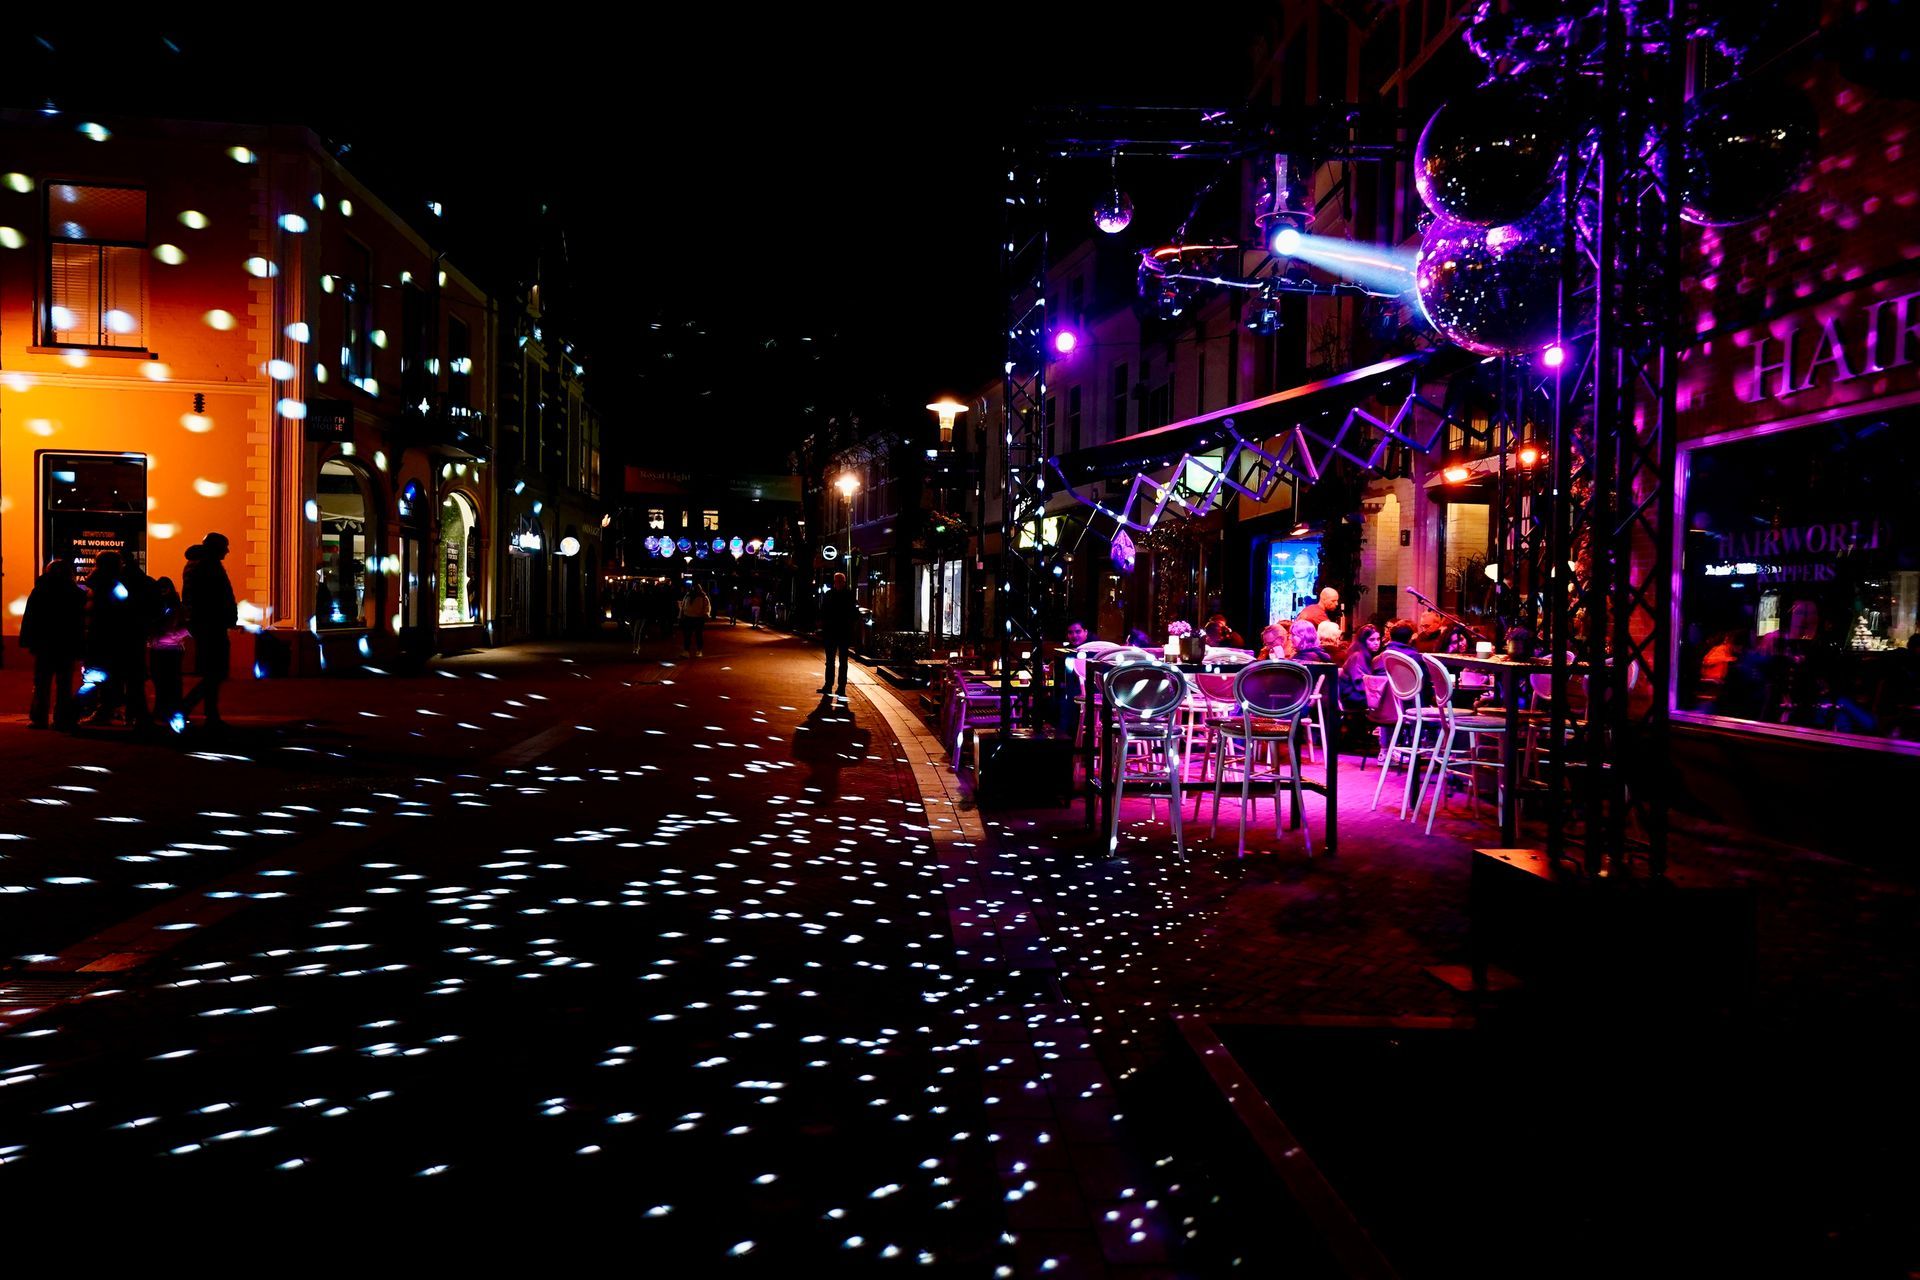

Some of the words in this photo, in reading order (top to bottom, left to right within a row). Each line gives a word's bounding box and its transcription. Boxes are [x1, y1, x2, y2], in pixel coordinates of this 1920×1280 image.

[1744, 290, 1920, 404] HAIR
[639, 470, 665, 482] Royal
[87, 539, 125, 547] WORKOUT
